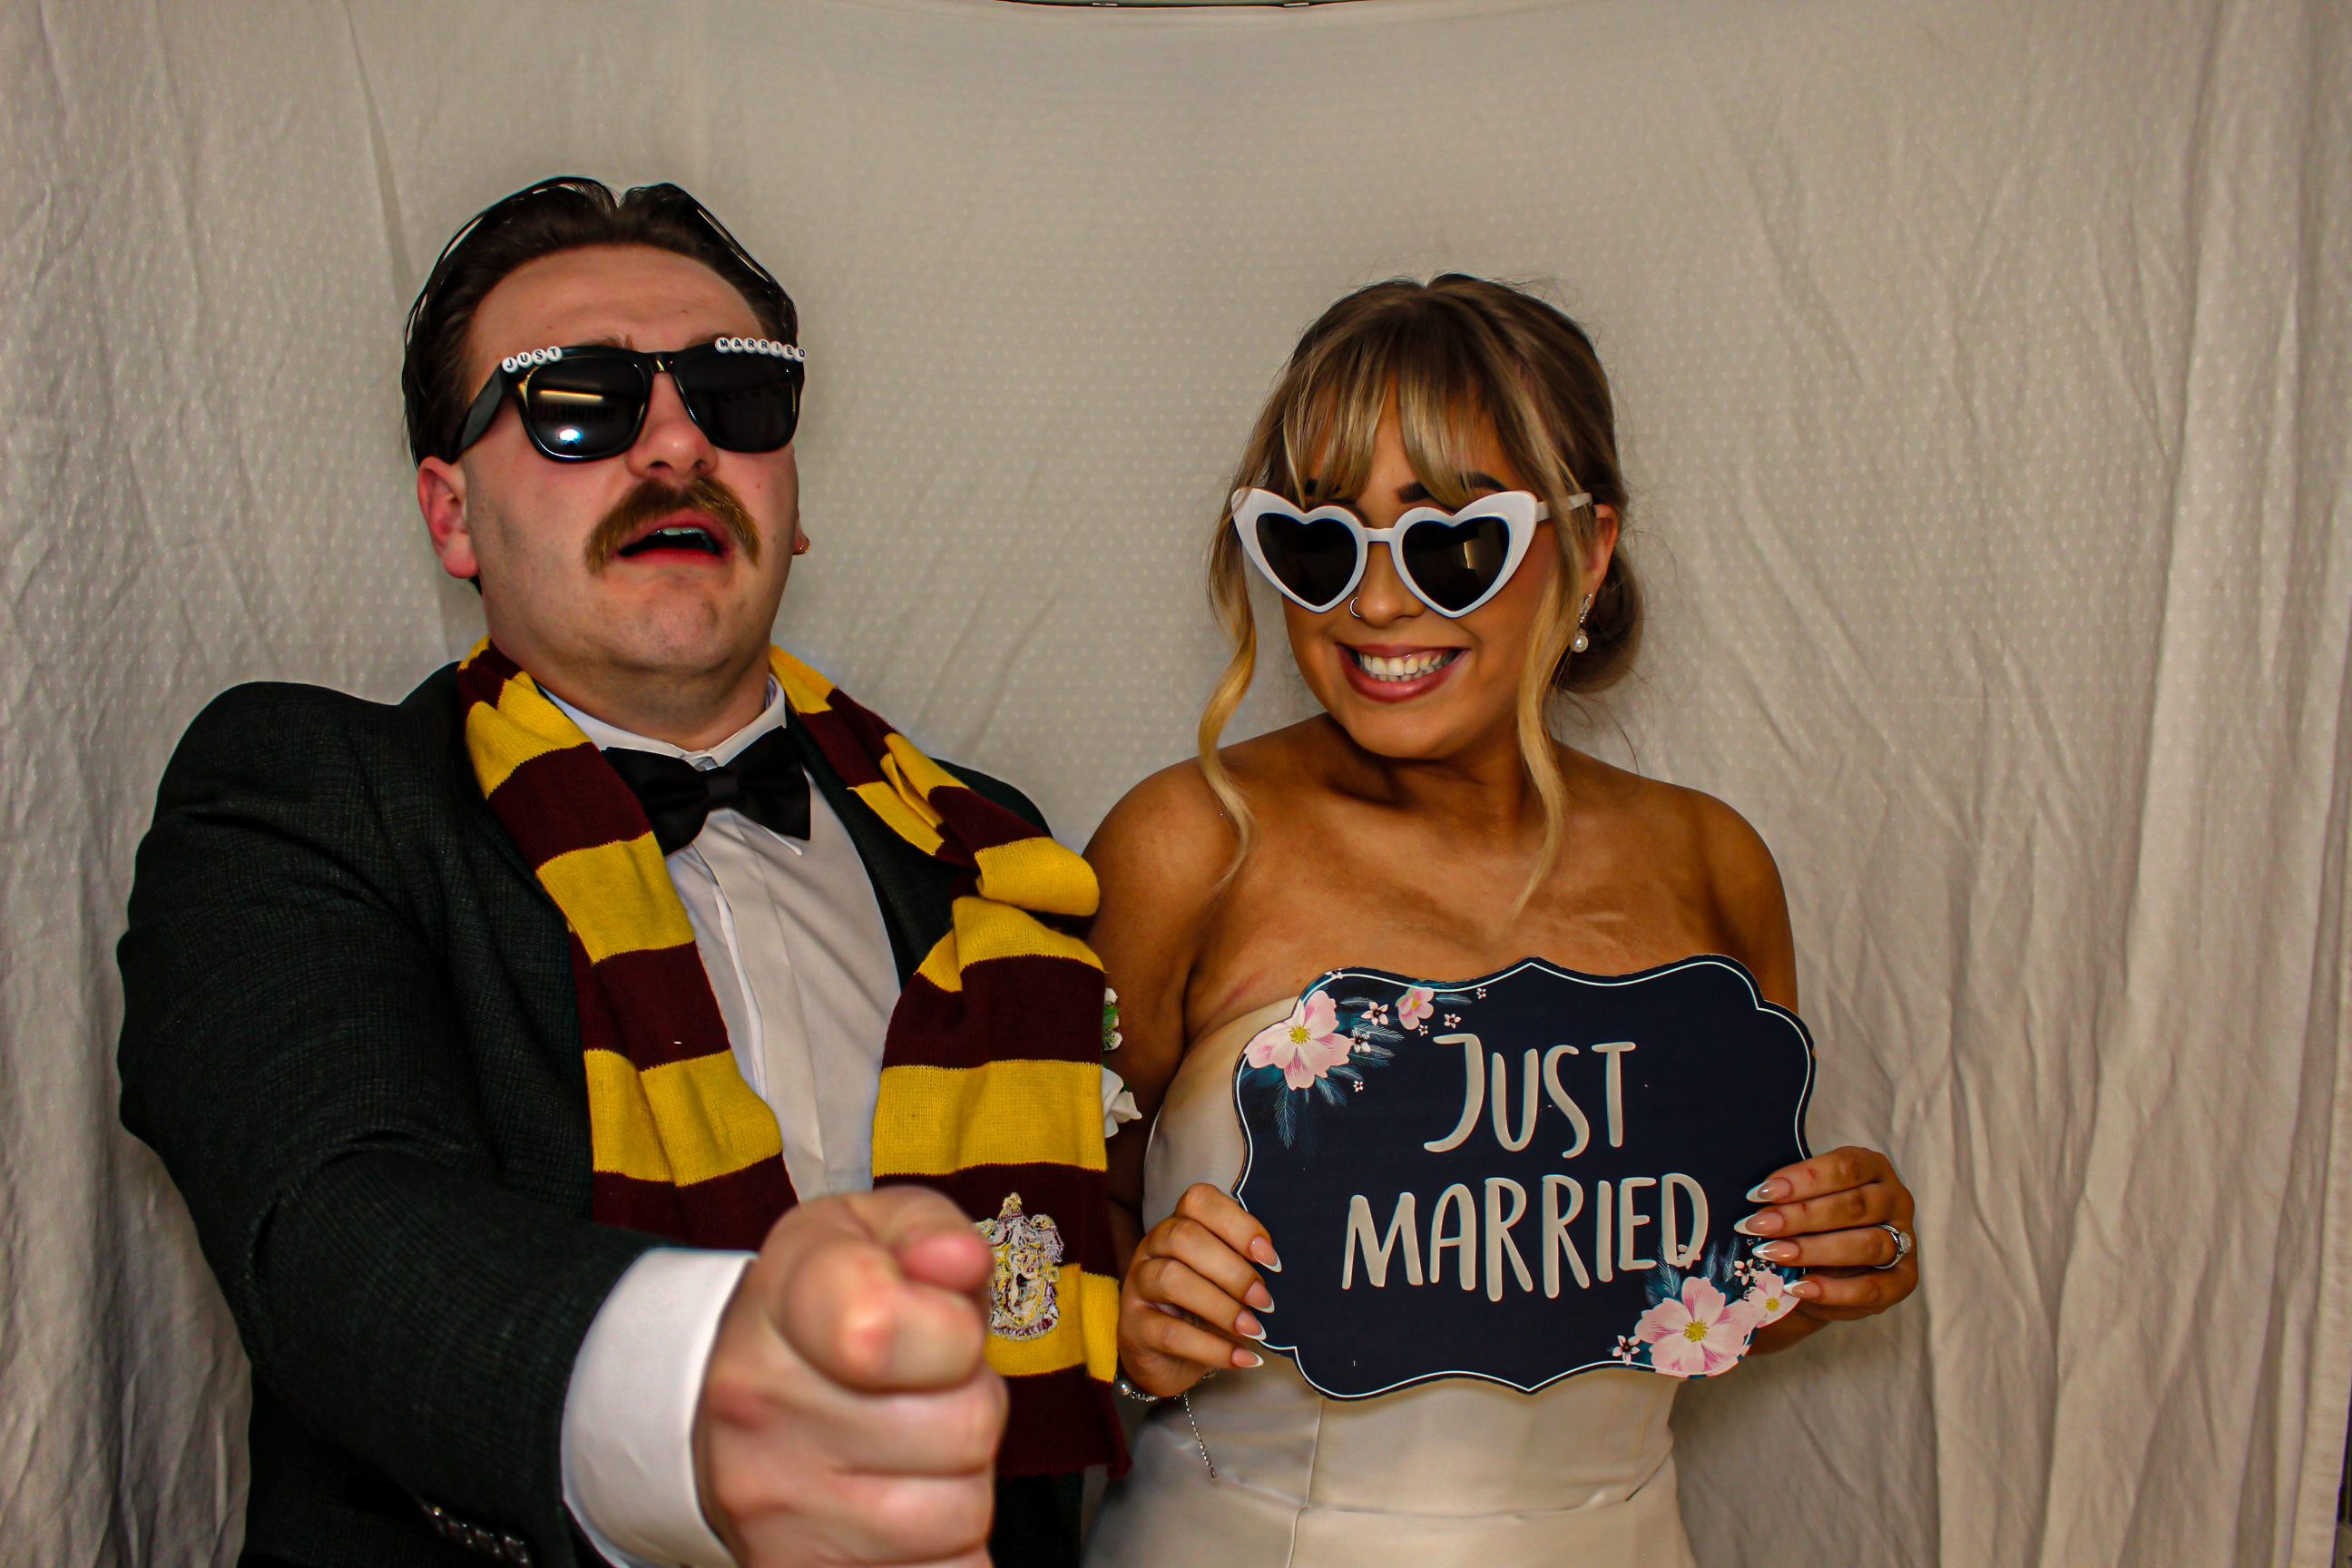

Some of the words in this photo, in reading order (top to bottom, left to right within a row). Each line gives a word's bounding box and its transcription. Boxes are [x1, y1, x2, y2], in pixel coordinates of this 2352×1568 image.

[505, 347, 558, 370] JUST
[718, 338, 806, 358] MARRIED
[1424, 1033, 1637, 1159] JUST
[1341, 1172, 1710, 1302] MARRIED
